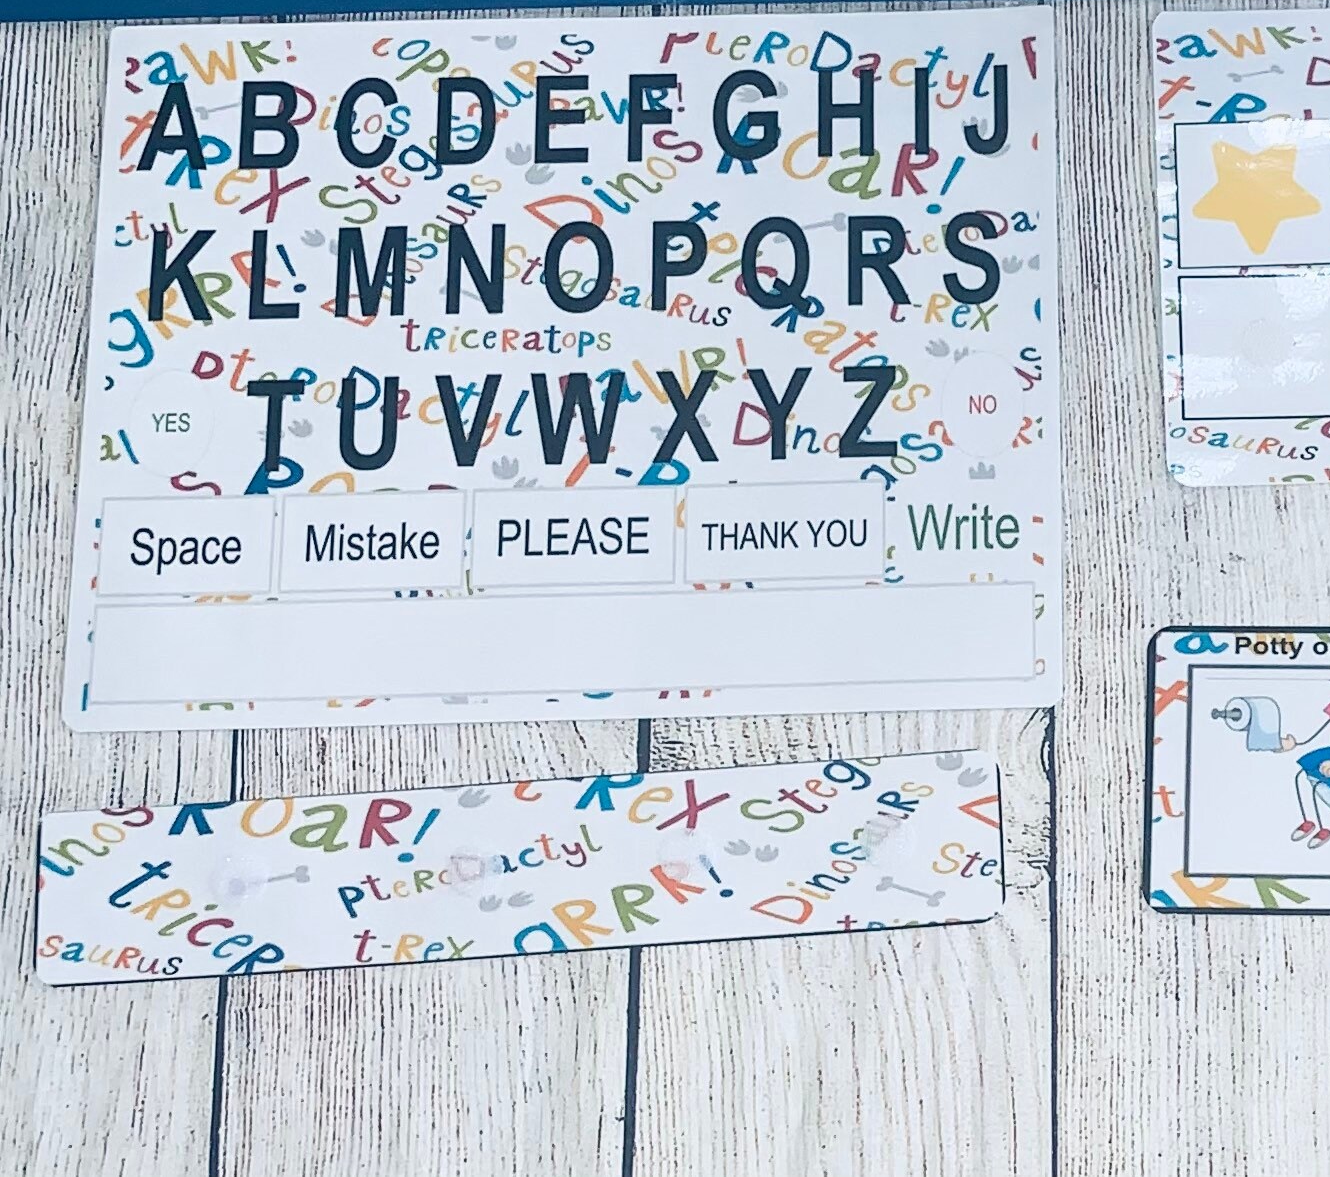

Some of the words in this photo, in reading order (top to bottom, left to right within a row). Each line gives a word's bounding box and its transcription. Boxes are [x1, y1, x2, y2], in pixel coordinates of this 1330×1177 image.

[151, 412, 191, 434] YES
[969, 394, 998, 415] NO
[304, 521, 440, 563] Mistake
[497, 516, 650, 558] PLEASE
[702, 520, 800, 551] THANK
[806, 519, 868, 550] YOU
[907, 502, 1021, 552] Write
[130, 527, 242, 575] Space
[1234, 636, 1304, 660] Potty
